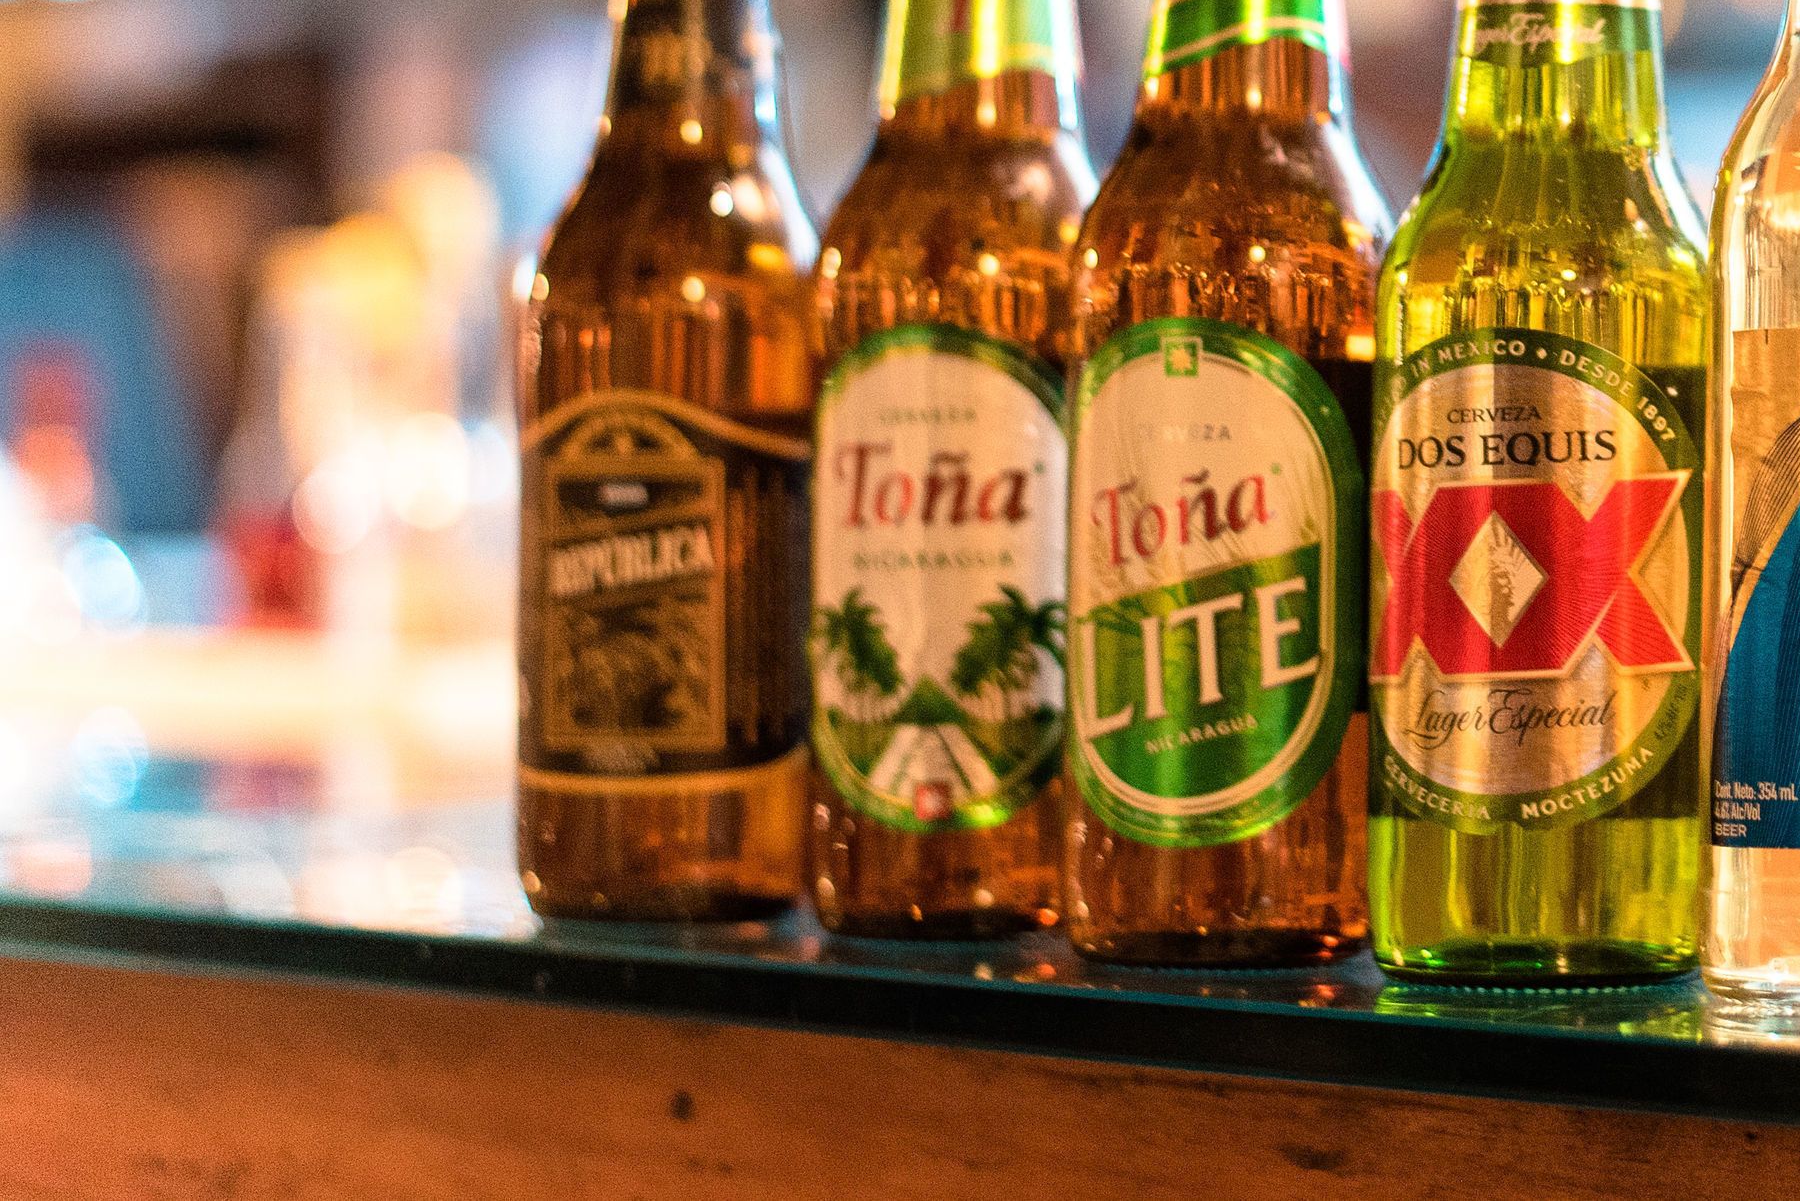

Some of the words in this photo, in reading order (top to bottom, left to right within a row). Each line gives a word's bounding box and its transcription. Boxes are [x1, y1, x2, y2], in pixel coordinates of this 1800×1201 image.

[1437, 339, 1526, 364] MEXICO
[1559, 349, 1635, 397] DESDE
[1636, 396, 1677, 441] 1897
[1446, 405, 1543, 424] CERVEZA
[1397, 434, 1467, 470] DOS
[1479, 429, 1618, 467] EQUIS
[832, 440, 1030, 529] Toña
[1090, 467, 1270, 567] Toña
[1076, 576, 1321, 739] LITE
[1403, 689, 1485, 750] Lager
[1486, 687, 1618, 748] Especial
[1520, 746, 1655, 820] MOCTEZUMA
[1757, 781, 1778, 801] 354
[1714, 822, 1748, 838] BEER
